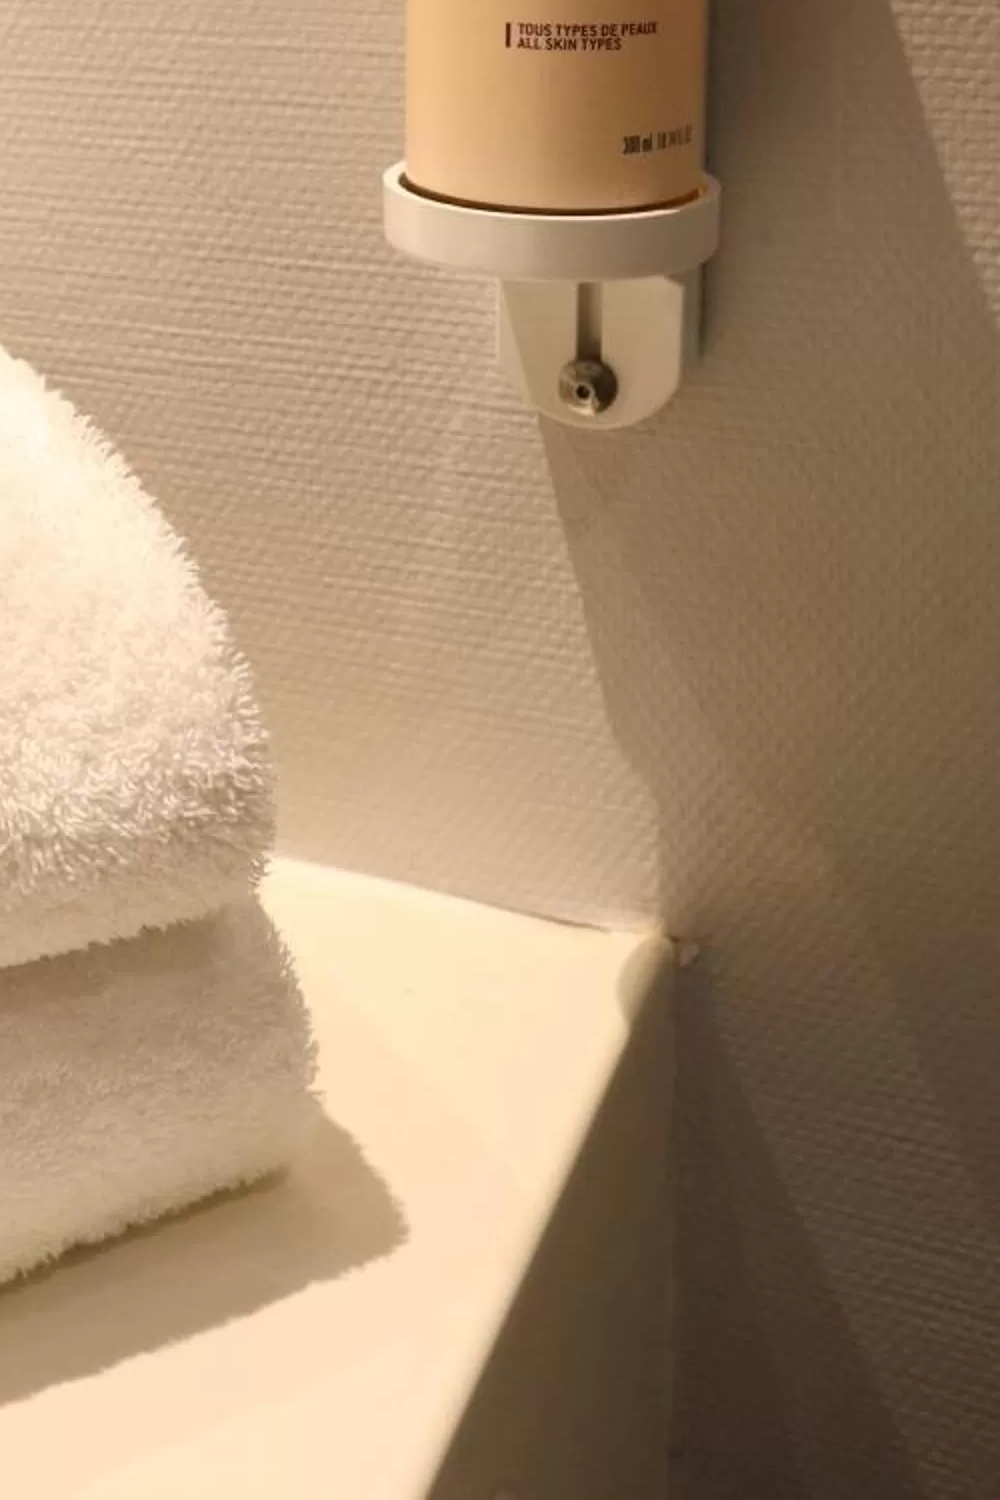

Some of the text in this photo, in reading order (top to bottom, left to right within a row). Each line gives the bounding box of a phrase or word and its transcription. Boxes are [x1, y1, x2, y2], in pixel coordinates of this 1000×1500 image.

[518, 22, 552, 37] TOUS
[556, 23, 598, 38] TYPES
[601, 23, 618, 37] DE
[516, 37, 622, 51] ALL SKIN TYPES
